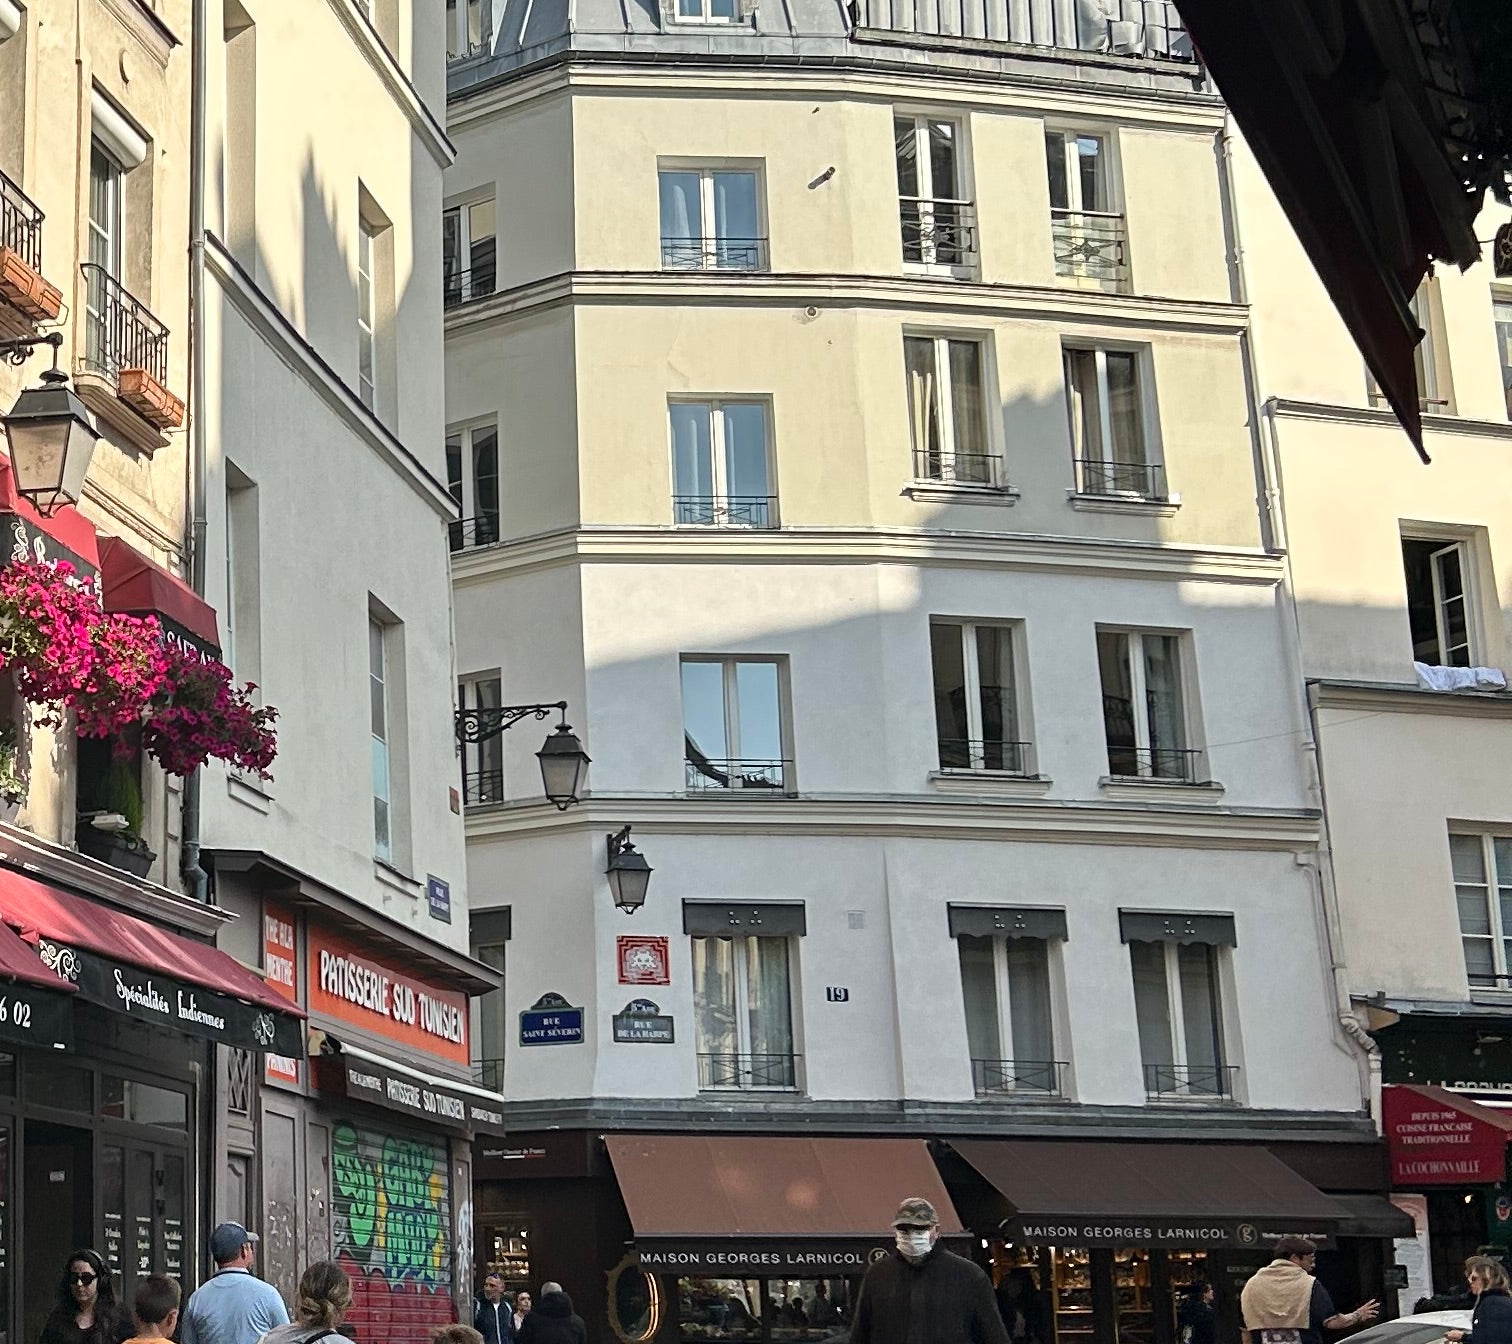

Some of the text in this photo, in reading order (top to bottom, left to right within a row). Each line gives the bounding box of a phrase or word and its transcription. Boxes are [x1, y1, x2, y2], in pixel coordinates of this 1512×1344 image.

[320, 949, 465, 1045] PATISSERIE SUD TUNISIEN
[829, 986, 845, 1001] 19
[12, 1001, 32, 1029] 02
[178, 989, 226, 1030] Indiennes
[1023, 1225, 1078, 1238] MAISON
[1083, 1226, 1153, 1240] GEORGES
[1157, 1227, 1229, 1240] LARNICOL
[639, 1251, 700, 1265] MAISON
[705, 1251, 781, 1265] GEORGES
[786, 1252, 864, 1265] LARNICOL
